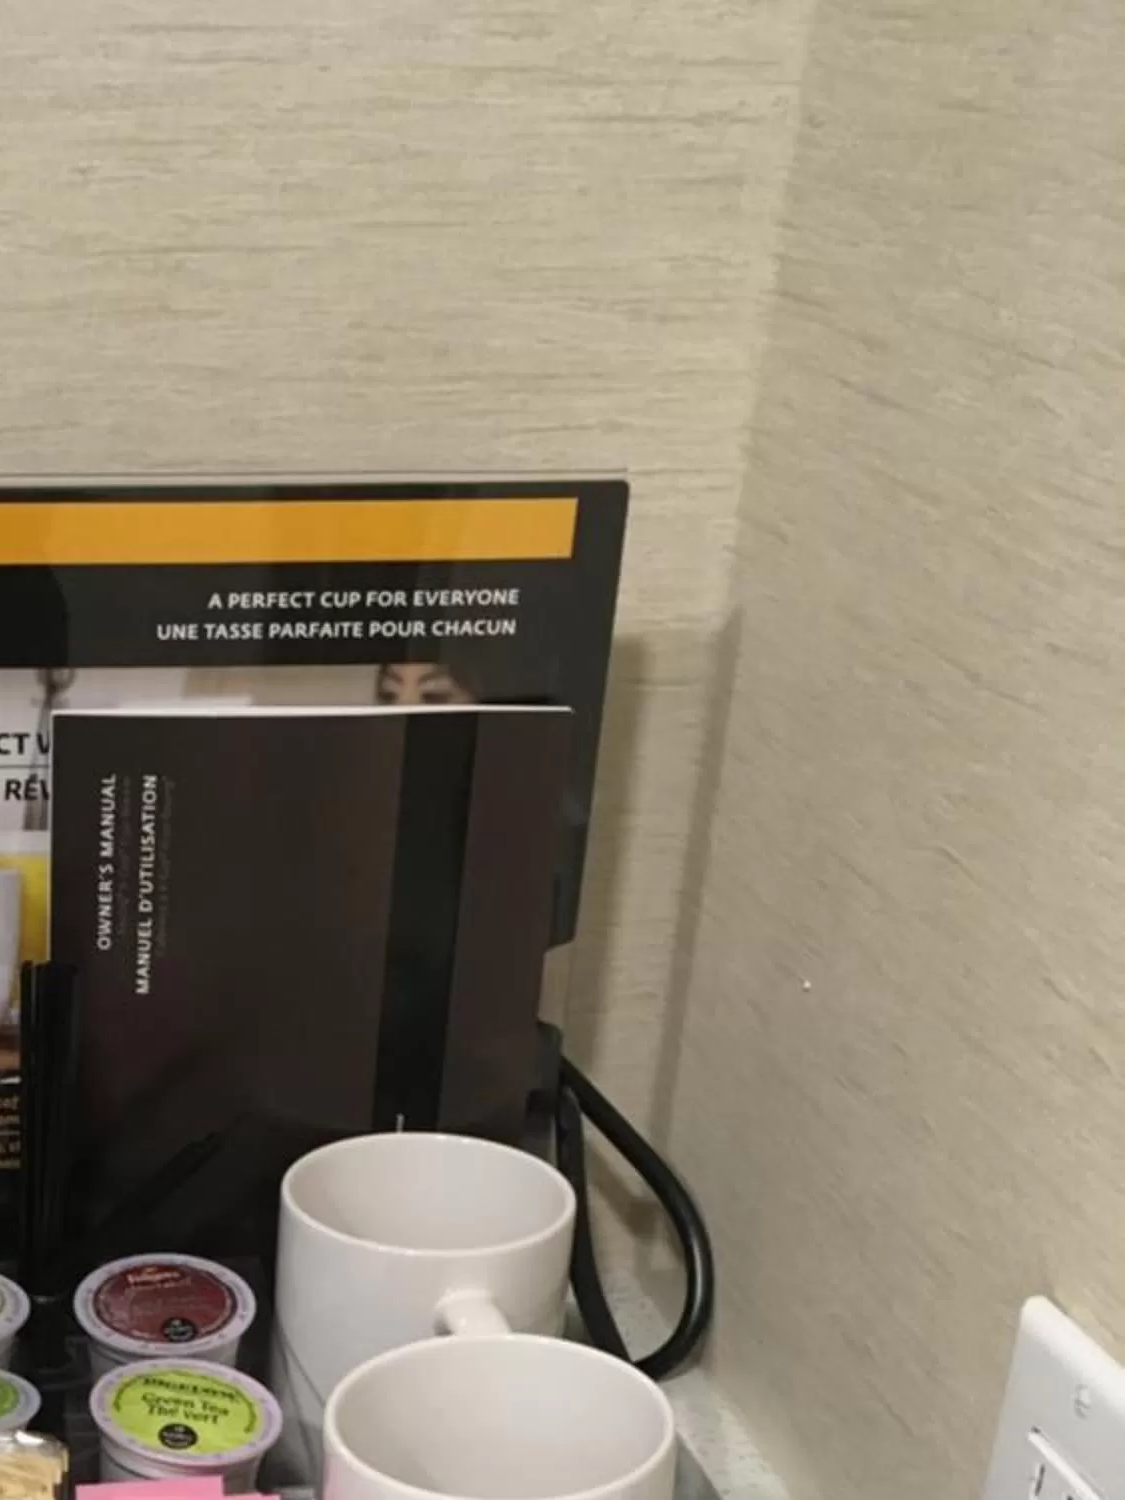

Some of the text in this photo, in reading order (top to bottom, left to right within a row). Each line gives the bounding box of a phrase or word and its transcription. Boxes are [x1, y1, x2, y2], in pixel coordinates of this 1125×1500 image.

[207, 588, 520, 611] A PERFECT CUP FOR EVERYONE
[156, 618, 518, 641] UNE TASSE PARFAITE POUR CHACUN
[96, 773, 117, 951] OWNER'S MANUAL
[135, 774, 158, 995] MANUEL D'UTILISATION
[141, 1390, 195, 1409] Green
